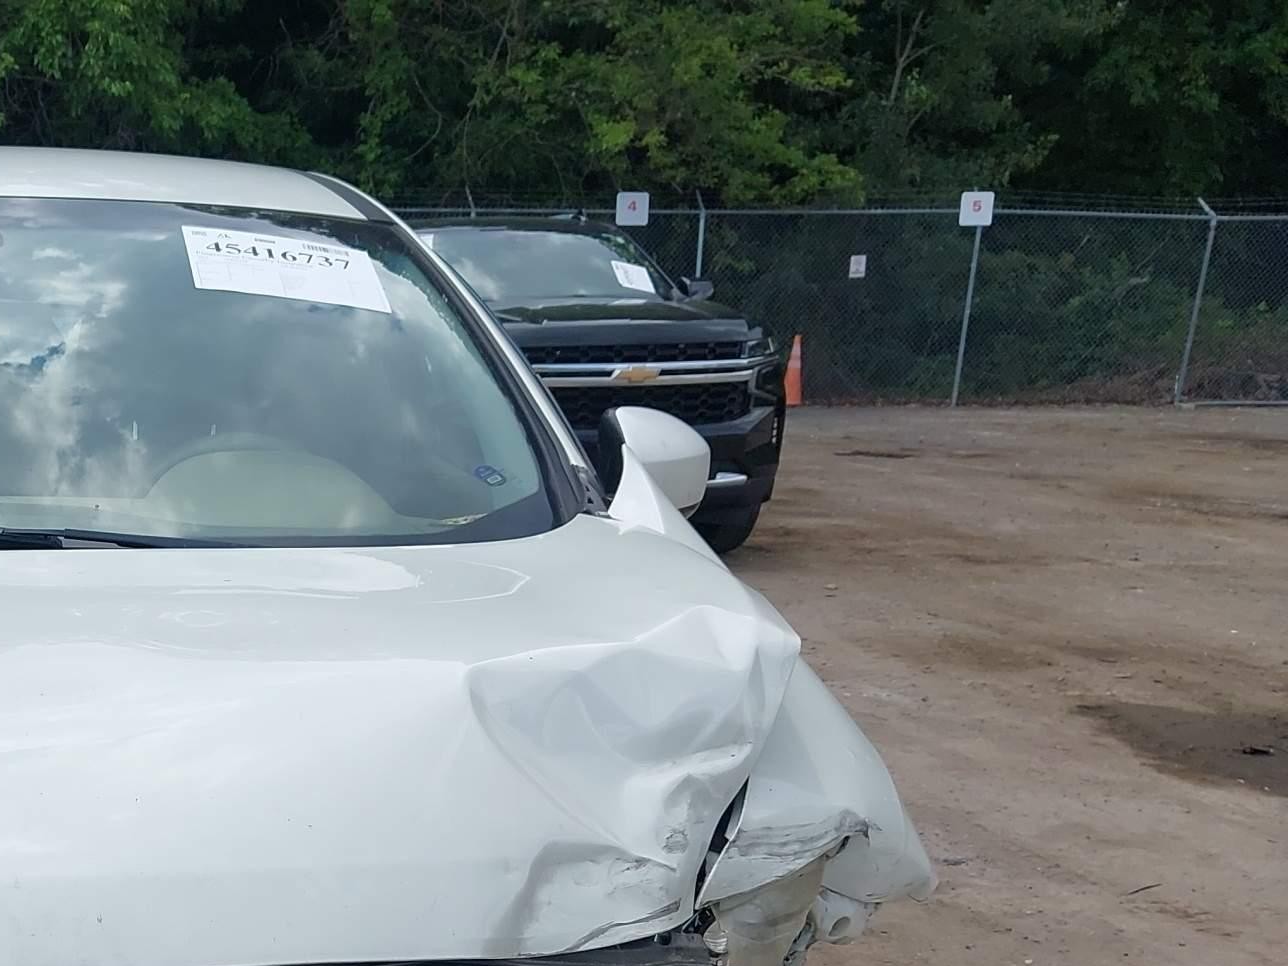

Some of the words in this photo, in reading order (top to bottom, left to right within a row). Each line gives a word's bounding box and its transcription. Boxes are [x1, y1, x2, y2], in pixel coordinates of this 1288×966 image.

[627, 200, 637, 212] 4
[972, 199, 983, 213] 5
[206, 241, 350, 270] 45416737
